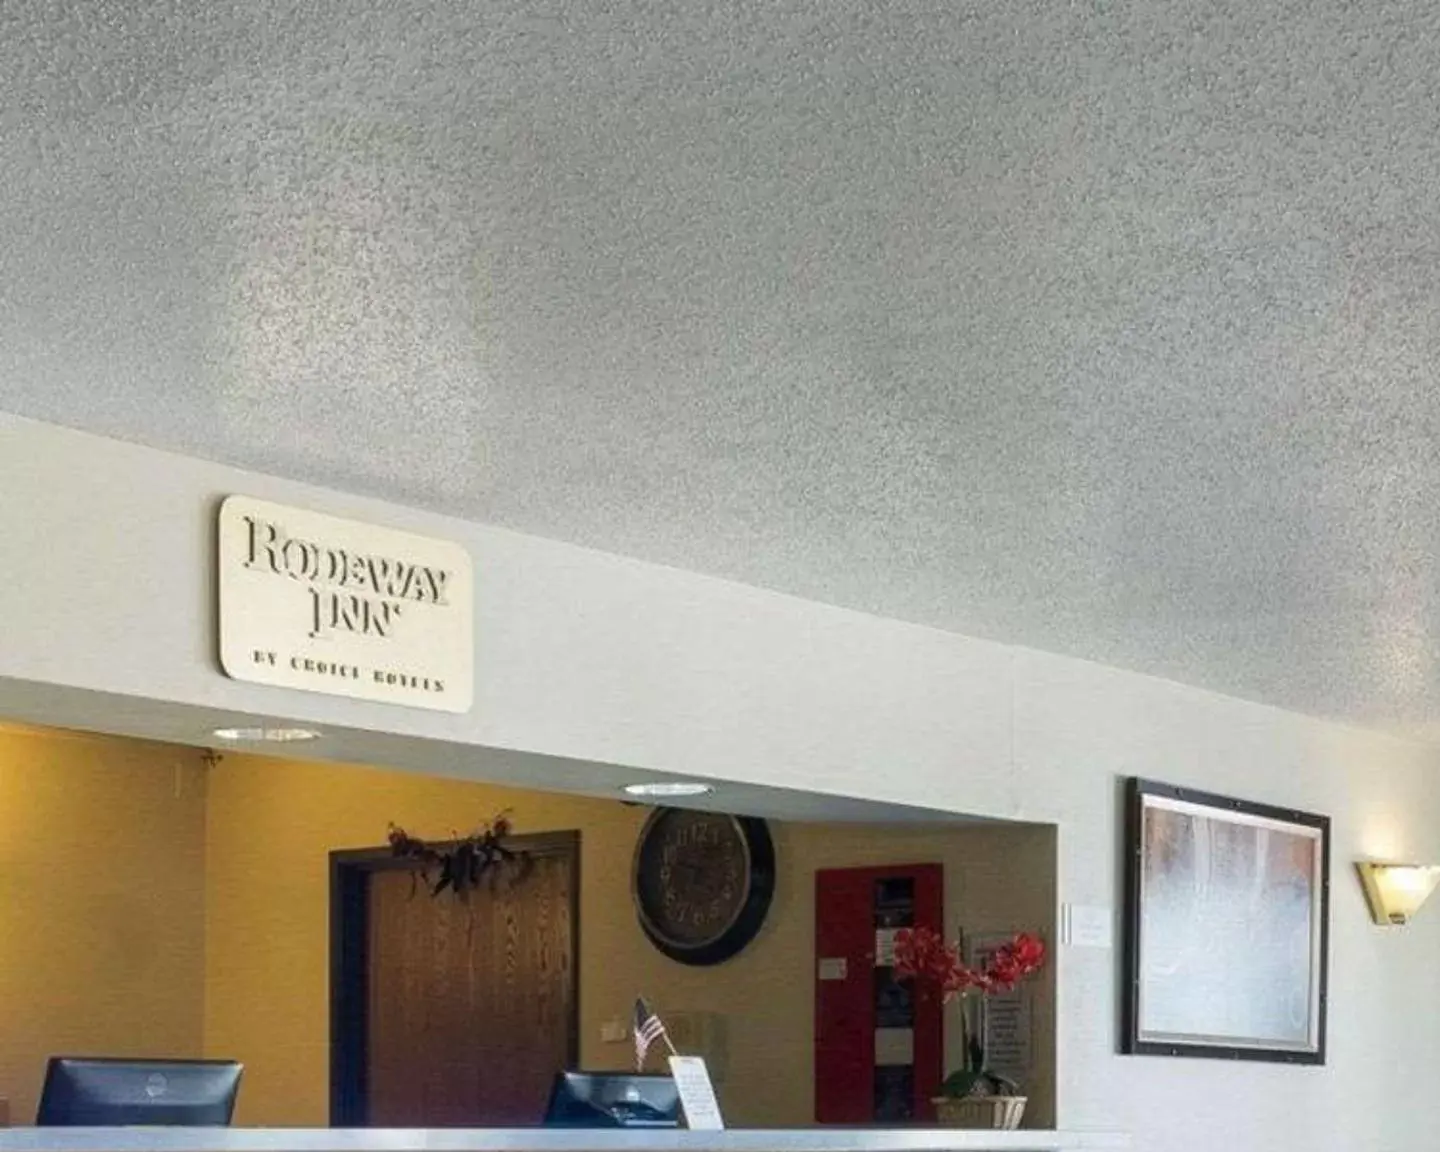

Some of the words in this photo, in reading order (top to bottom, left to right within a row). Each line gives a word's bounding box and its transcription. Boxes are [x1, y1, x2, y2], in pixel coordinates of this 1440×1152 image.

[243, 515, 449, 605] RODEWAY
[307, 586, 401, 639] INN
[253, 649, 278, 667] BY
[290, 656, 360, 681] CHOICE
[373, 669, 446, 693] HOTELS
